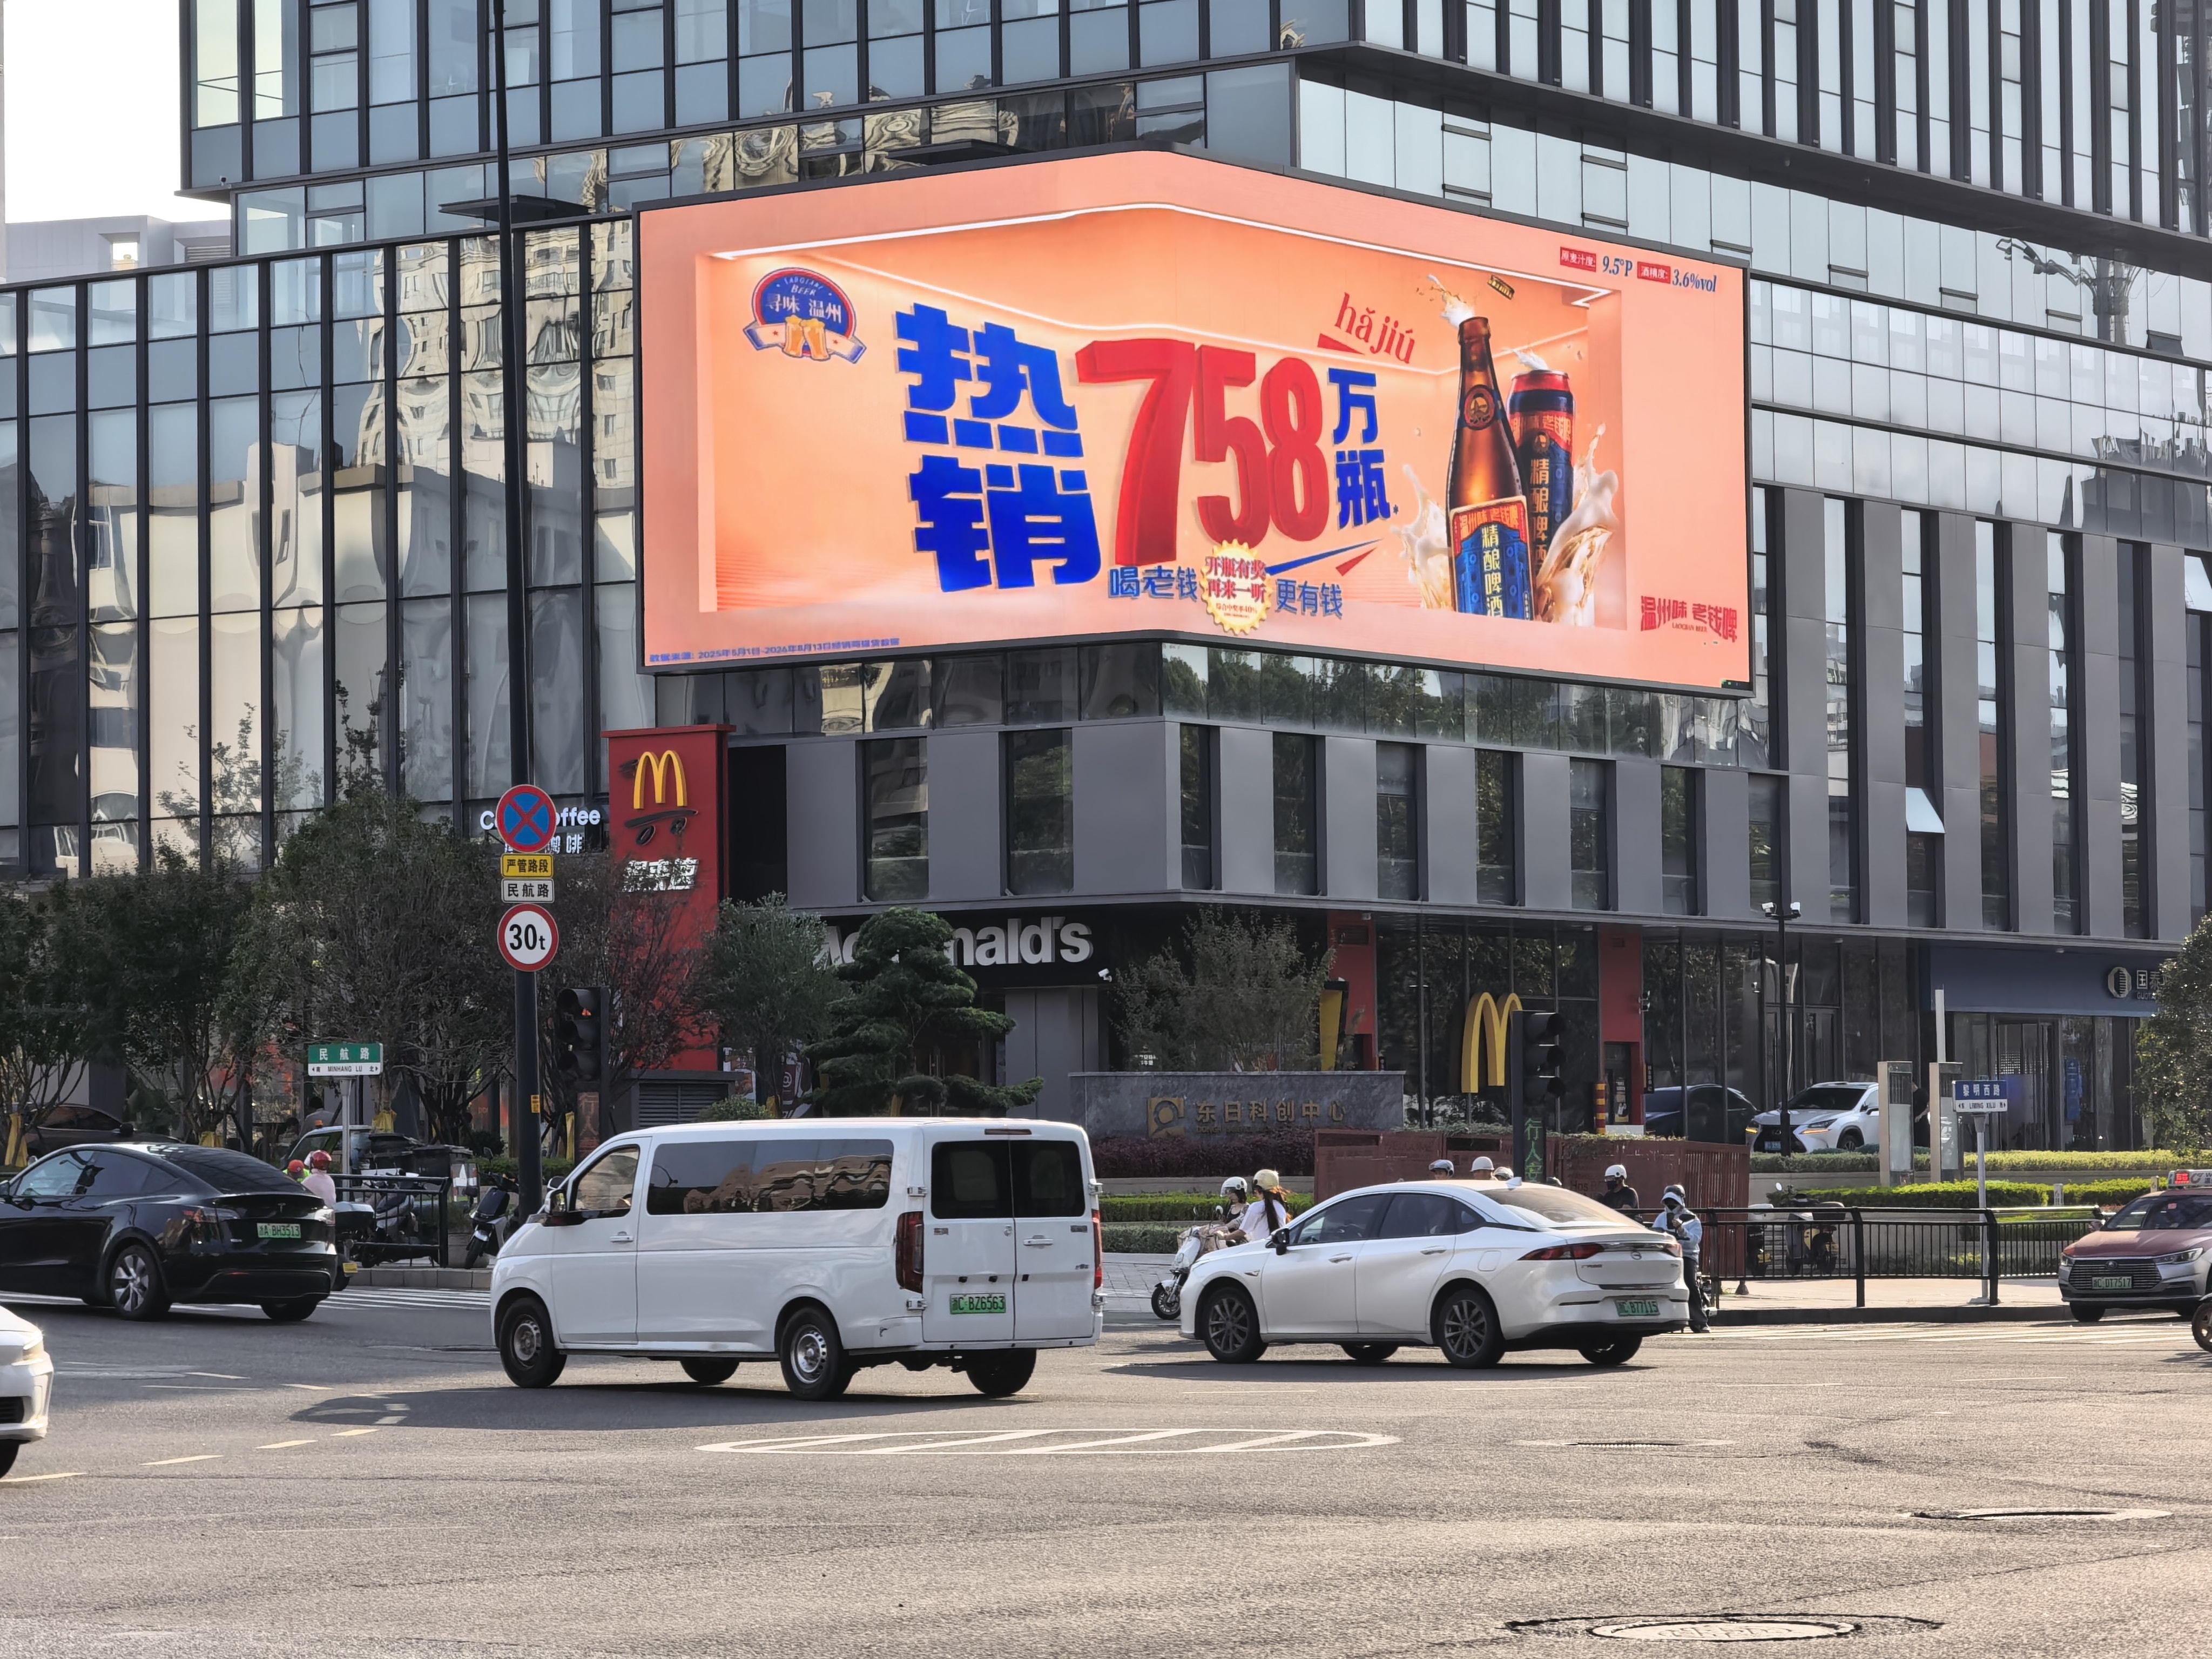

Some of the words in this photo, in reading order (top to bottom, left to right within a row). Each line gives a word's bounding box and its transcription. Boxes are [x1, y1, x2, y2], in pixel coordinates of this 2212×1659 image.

[1672, 269, 1717, 292] 3.6%vol
[809, 298, 842, 323] 温州
[895, 303, 1102, 593] 热销
[1075, 339, 1330, 565] 758
[1205, 556, 1266, 581] 开瓶有奖
[1482, 524, 1503, 617] 精酿啤酒
[1109, 565, 1198, 602] 喝老钱
[1275, 578, 1343, 619] 更有钱
[1207, 578, 1266, 603] 再来一听
[1641, 596, 1687, 631] 温州味
[1692, 603, 1737, 643] 老钱啤
[506, 858, 549, 874] 严管路段
[507, 882, 550, 898] 民航路
[509, 924, 546, 951] 30t
[319, 1047, 370, 1061] 民航路
[1963, 1083, 2000, 1097] 黎明西路
[1196, 1100, 1346, 1123] 东日科创中心
